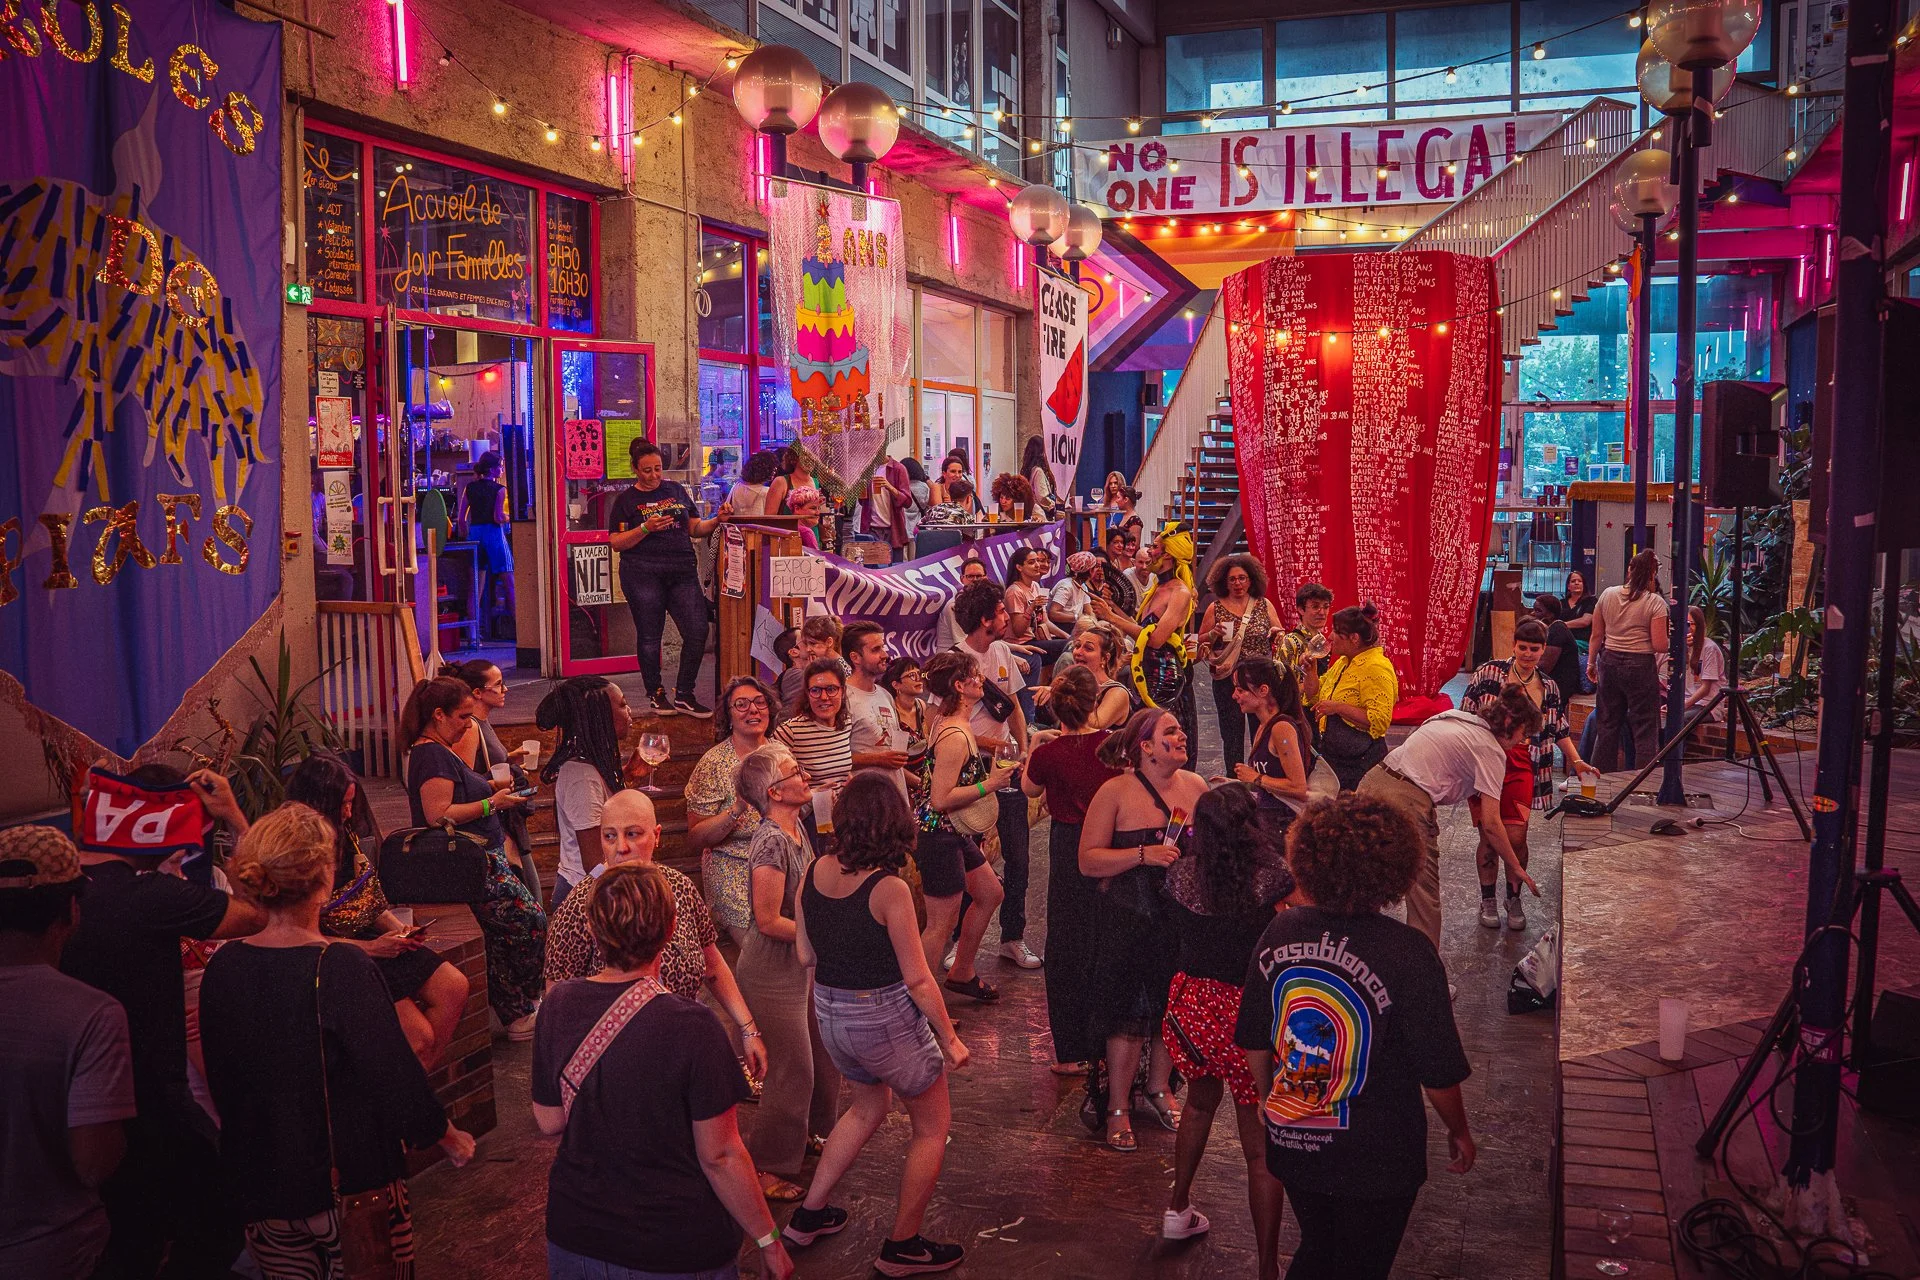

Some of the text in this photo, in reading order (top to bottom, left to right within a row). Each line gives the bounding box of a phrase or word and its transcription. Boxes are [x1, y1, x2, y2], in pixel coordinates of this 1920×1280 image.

[1108, 140, 1168, 172] NO
[1220, 136, 1259, 207] IS
[1106, 175, 1196, 212] ONE
[383, 175, 501, 225] Accueil de
[843, 227, 888, 269] ANS
[549, 243, 580, 271] 9H30
[1352, 255, 1386, 263] CAROLE
[1400, 255, 1419, 263] ANS
[395, 233, 524, 292] jour Familles
[1288, 261, 1305, 269] ANS
[1401, 263, 1413, 271] 62
[1415, 263, 1433, 272] ANS
[1295, 274, 1312, 283] ANS
[1402, 271, 1418, 279] ANS
[550, 267, 589, 297] 16H30
[1289, 282, 1306, 290] ANS
[1353, 277, 1436, 288] UNE FEMME 66 ANS
[1281, 290, 1290, 298] 60
[1381, 292, 1397, 300] ANS
[1398, 299, 1413, 307] ANS
[1410, 307, 1426, 315] ANS
[1394, 335, 1410, 343] ANS
[1399, 350, 1416, 358] ANS
[1304, 358, 1317, 366] ANS
[1408, 371, 1424, 381] ANS
[1407, 379, 1424, 389] ANS
[1390, 385, 1408, 393] ANS
[1390, 393, 1407, 401] ANS
[1390, 400, 1407, 408] ANS
[1380, 405, 1398, 413] ANS
[1338, 411, 1349, 419] ANS
[1400, 415, 1418, 424] ANS
[1299, 427, 1318, 436] ANS
[1408, 422, 1426, 432] ANS
[1051, 433, 1077, 466] NOW
[775, 559, 811, 575] EXPO
[576, 557, 608, 593] NIE
[772, 575, 825, 595] PHOTOS
[85, 789, 184, 843] PA
[1259, 931, 1393, 1015] Casablanca
